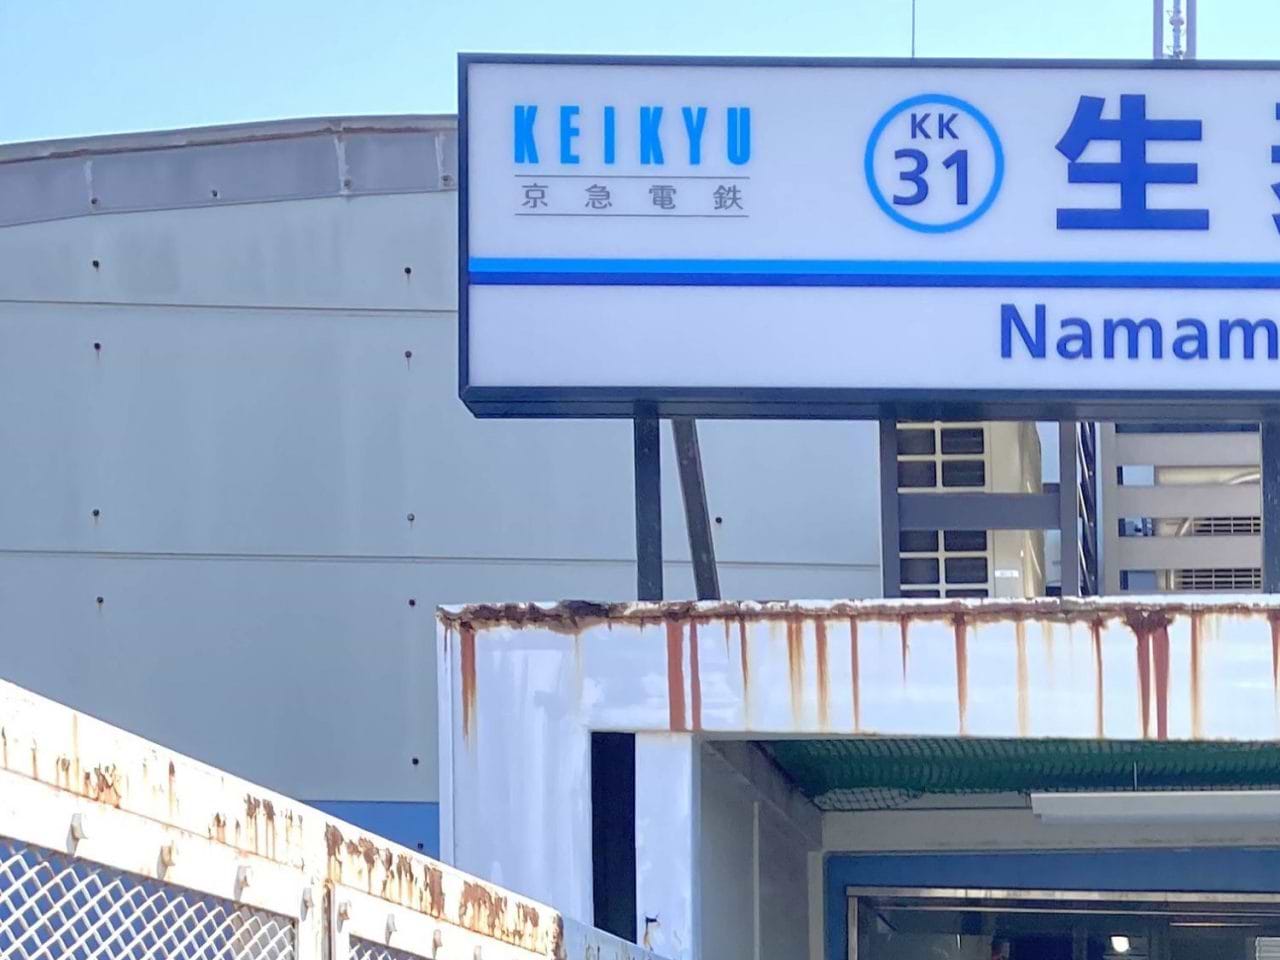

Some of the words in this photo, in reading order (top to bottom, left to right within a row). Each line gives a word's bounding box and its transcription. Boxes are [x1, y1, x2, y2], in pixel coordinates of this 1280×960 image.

[513, 105, 752, 166] KEIKYU
[910, 112, 959, 140] KK
[521, 182, 745, 212] 京急電鉄
[891, 147, 970, 206] 31
